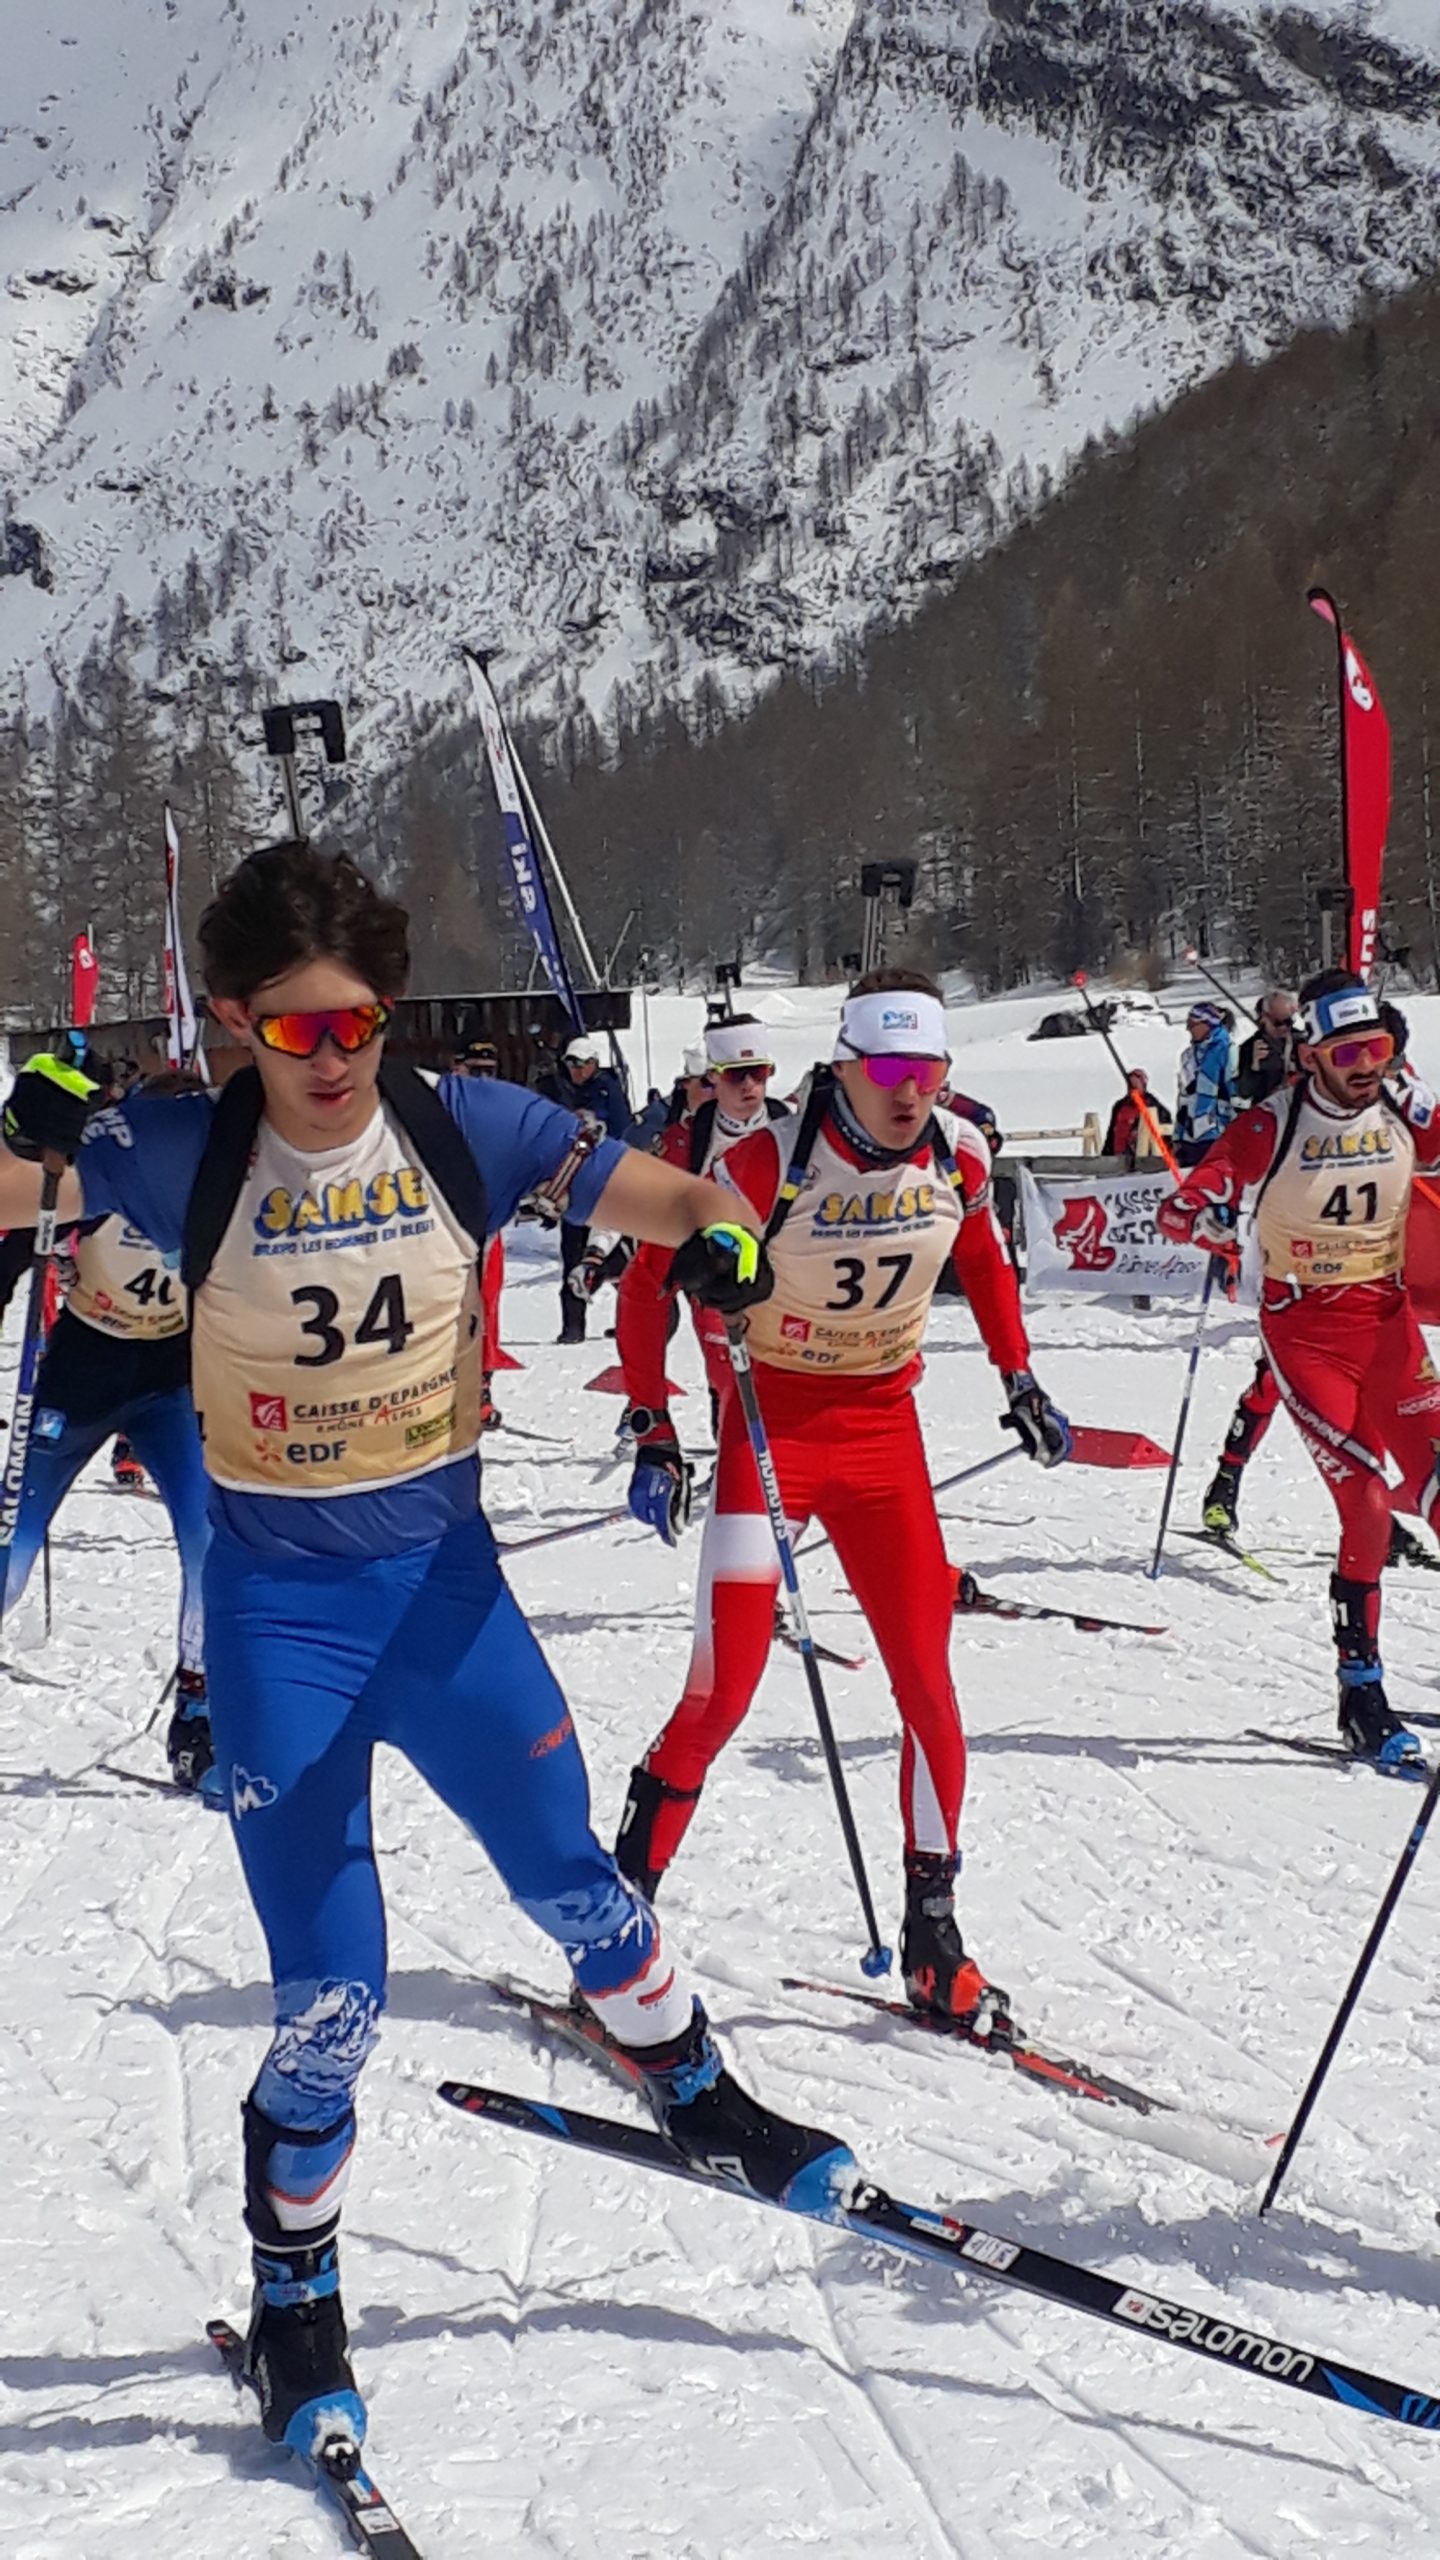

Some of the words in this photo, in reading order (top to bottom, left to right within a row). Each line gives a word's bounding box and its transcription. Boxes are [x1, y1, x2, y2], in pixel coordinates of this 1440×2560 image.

[1302, 1128, 1392, 1161] SAMSE
[254, 1166, 430, 1239] SAMSE
[814, 1184, 935, 1226] SAMSE
[1320, 1181, 1377, 1225] 41
[825, 1253, 912, 1310] 37
[290, 1274, 414, 1367] 34
[293, 1401, 360, 1419] CAISSE
[369, 1367, 458, 1410] D'EPARGNE
[0, 1392, 34, 1546] SALOMON
